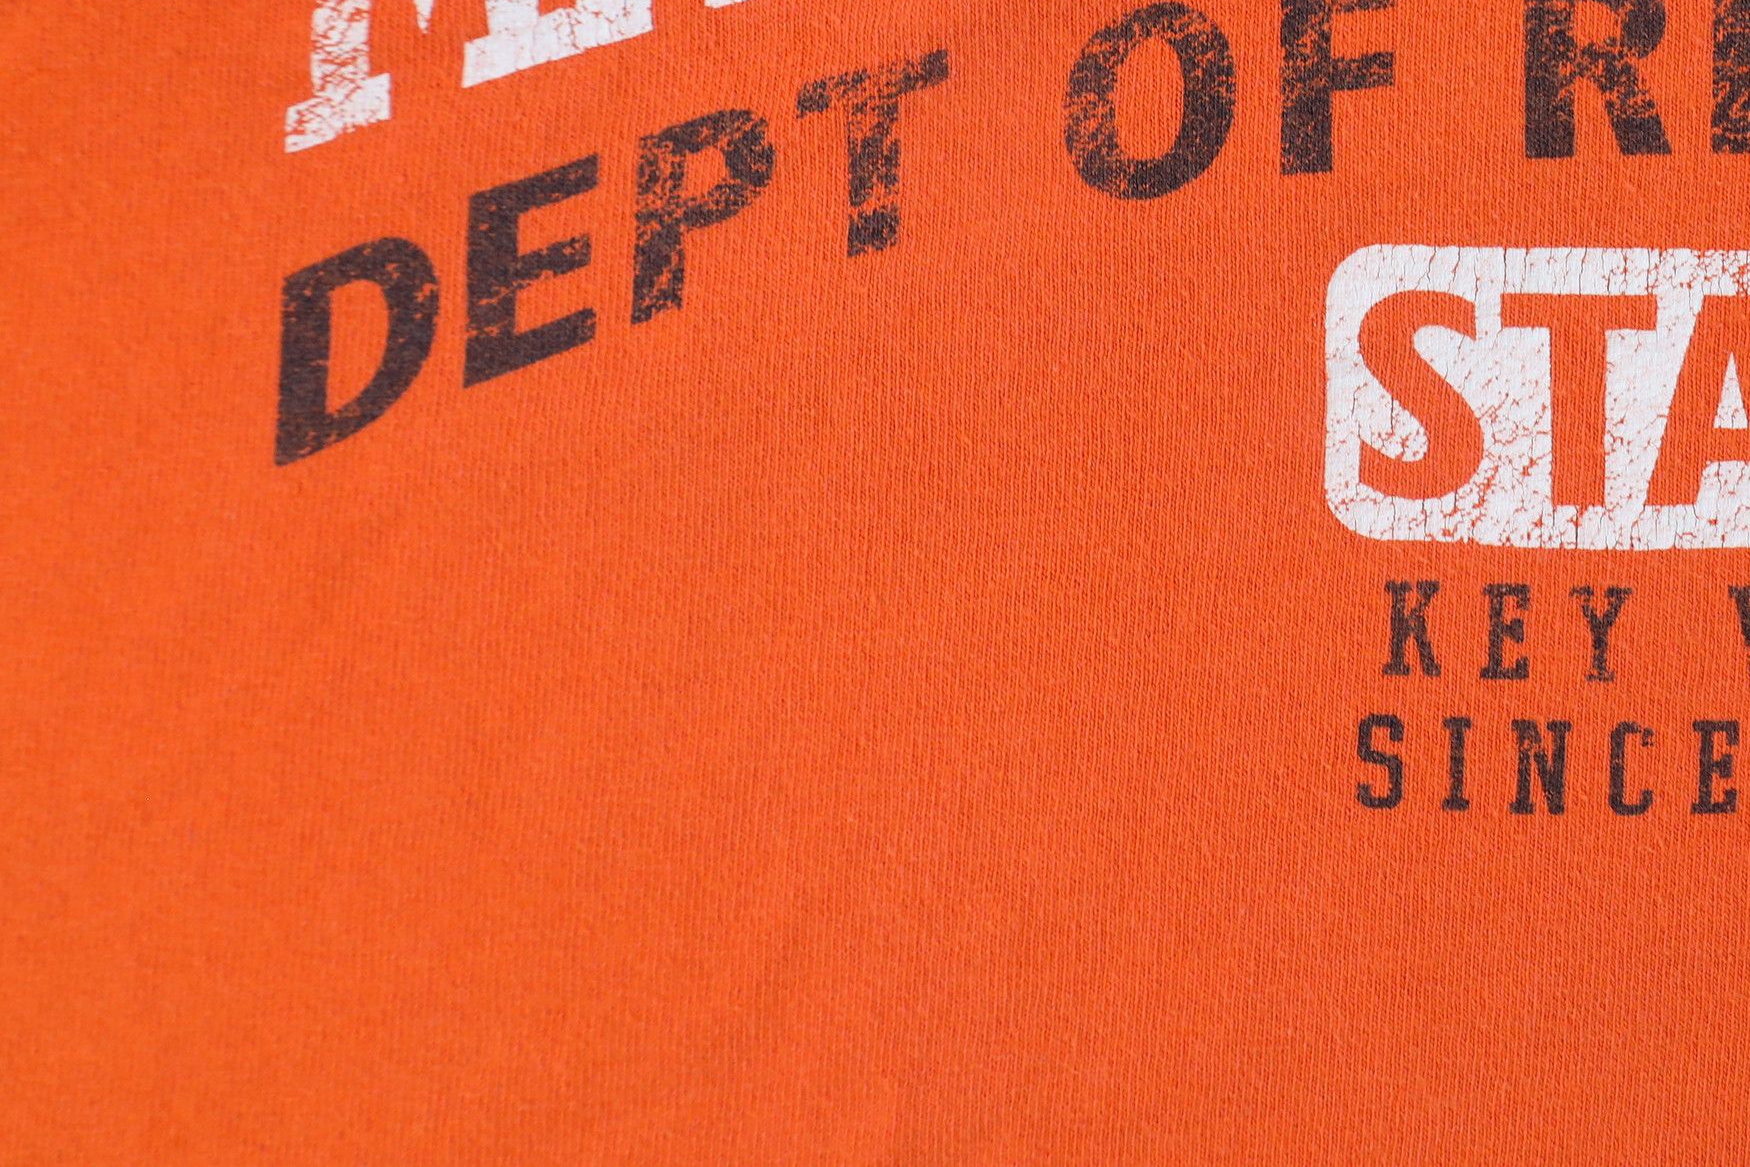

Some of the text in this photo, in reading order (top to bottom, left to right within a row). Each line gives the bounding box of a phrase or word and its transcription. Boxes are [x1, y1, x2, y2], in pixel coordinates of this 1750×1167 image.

[277, 51, 949, 466] DEPT
[1383, 581, 1631, 681] KEY
[1356, 714, 1740, 815] SINCE
